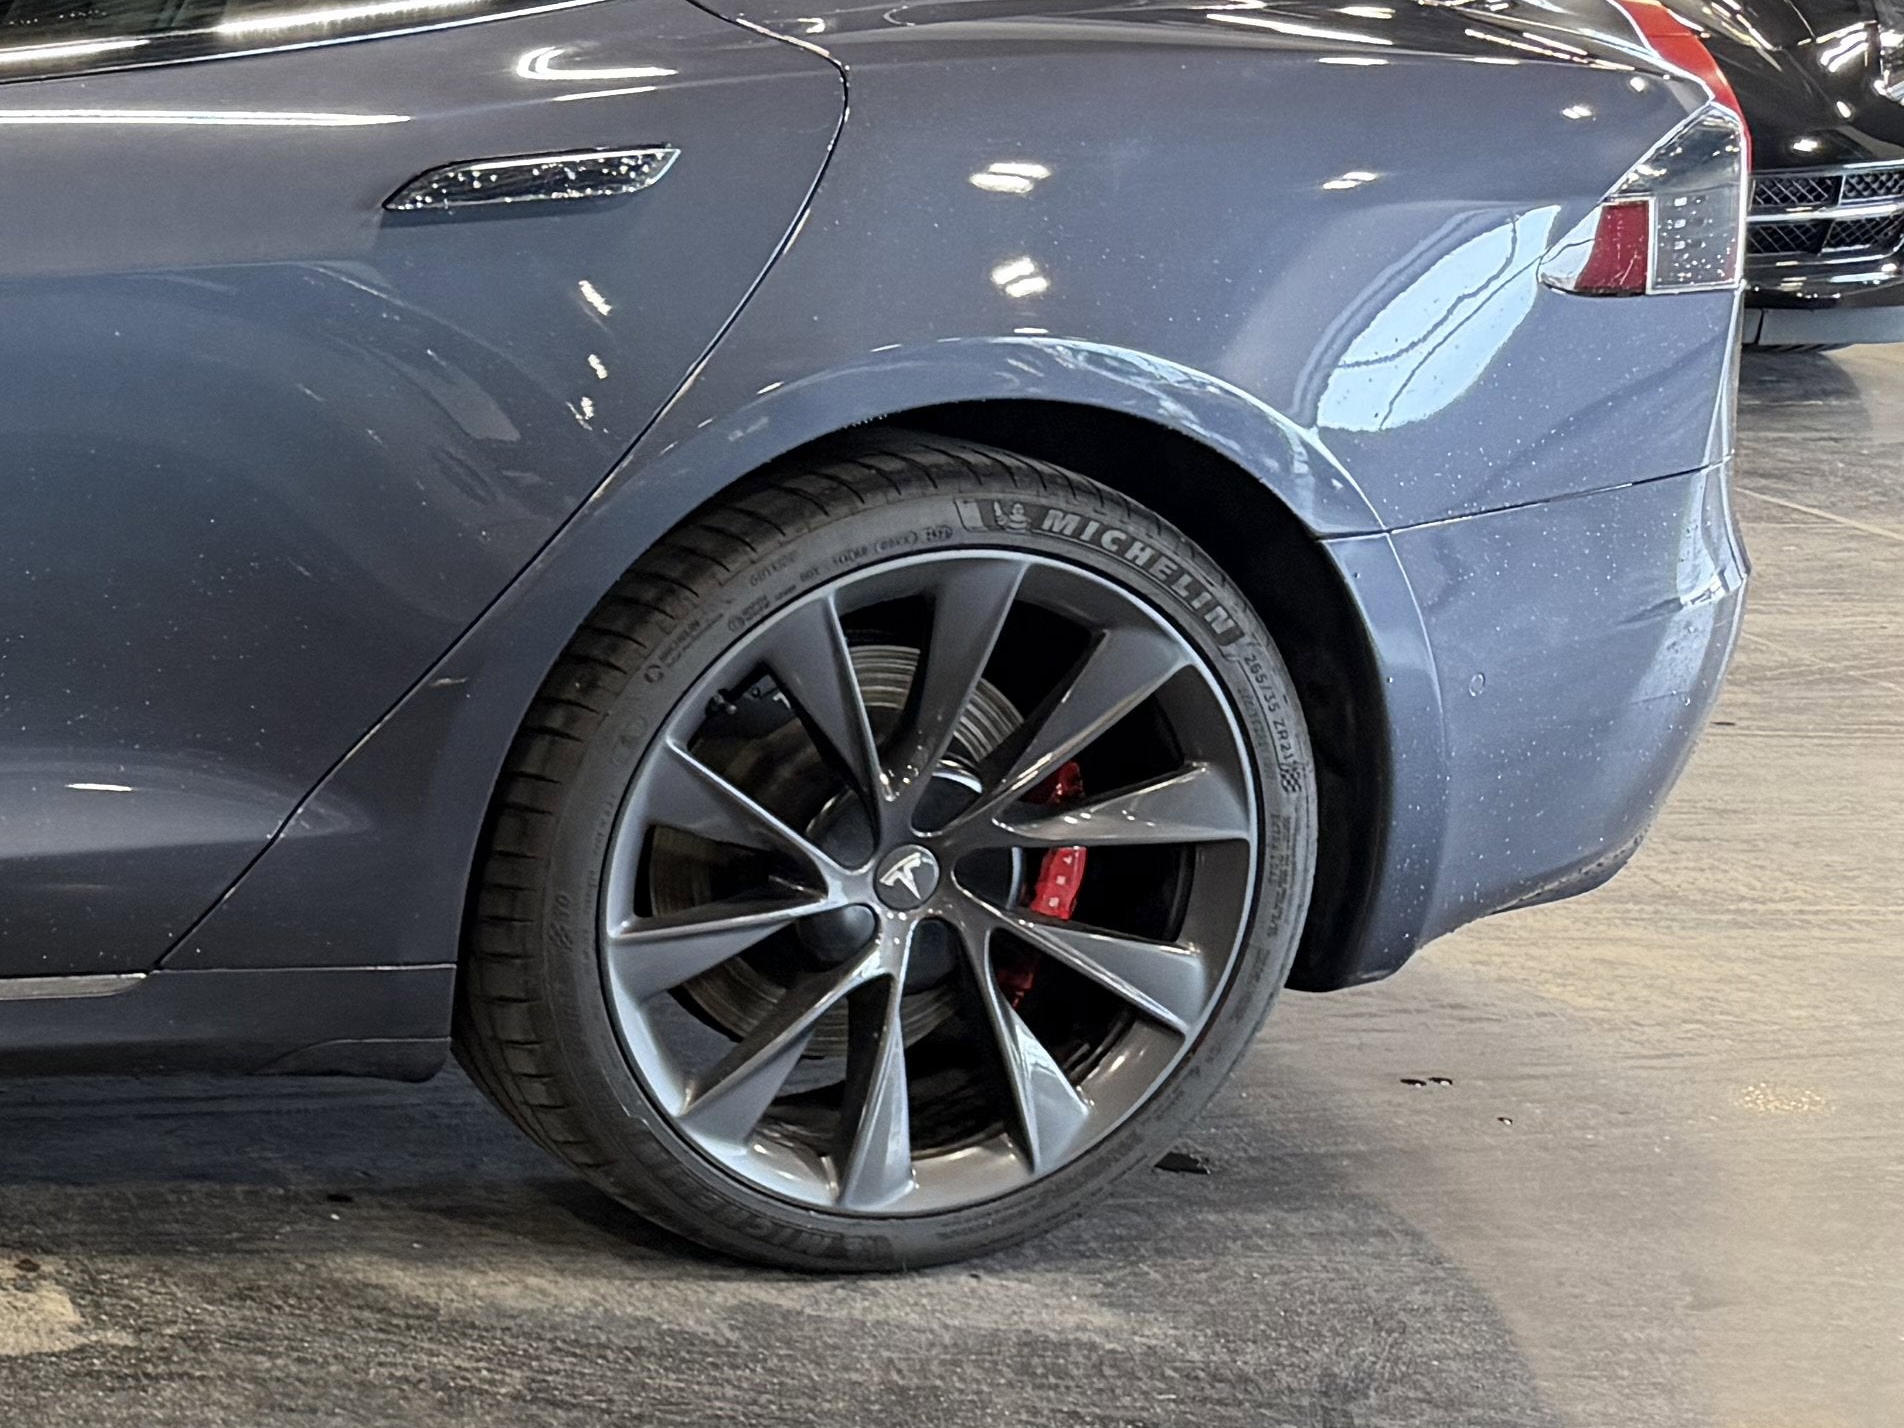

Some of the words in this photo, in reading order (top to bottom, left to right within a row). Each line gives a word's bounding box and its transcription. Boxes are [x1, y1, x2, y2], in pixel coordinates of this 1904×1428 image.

[1042, 508, 1236, 635] MICHELIN
[1244, 653, 1281, 713] 265/35
[1273, 718, 1294, 760] ZR21
